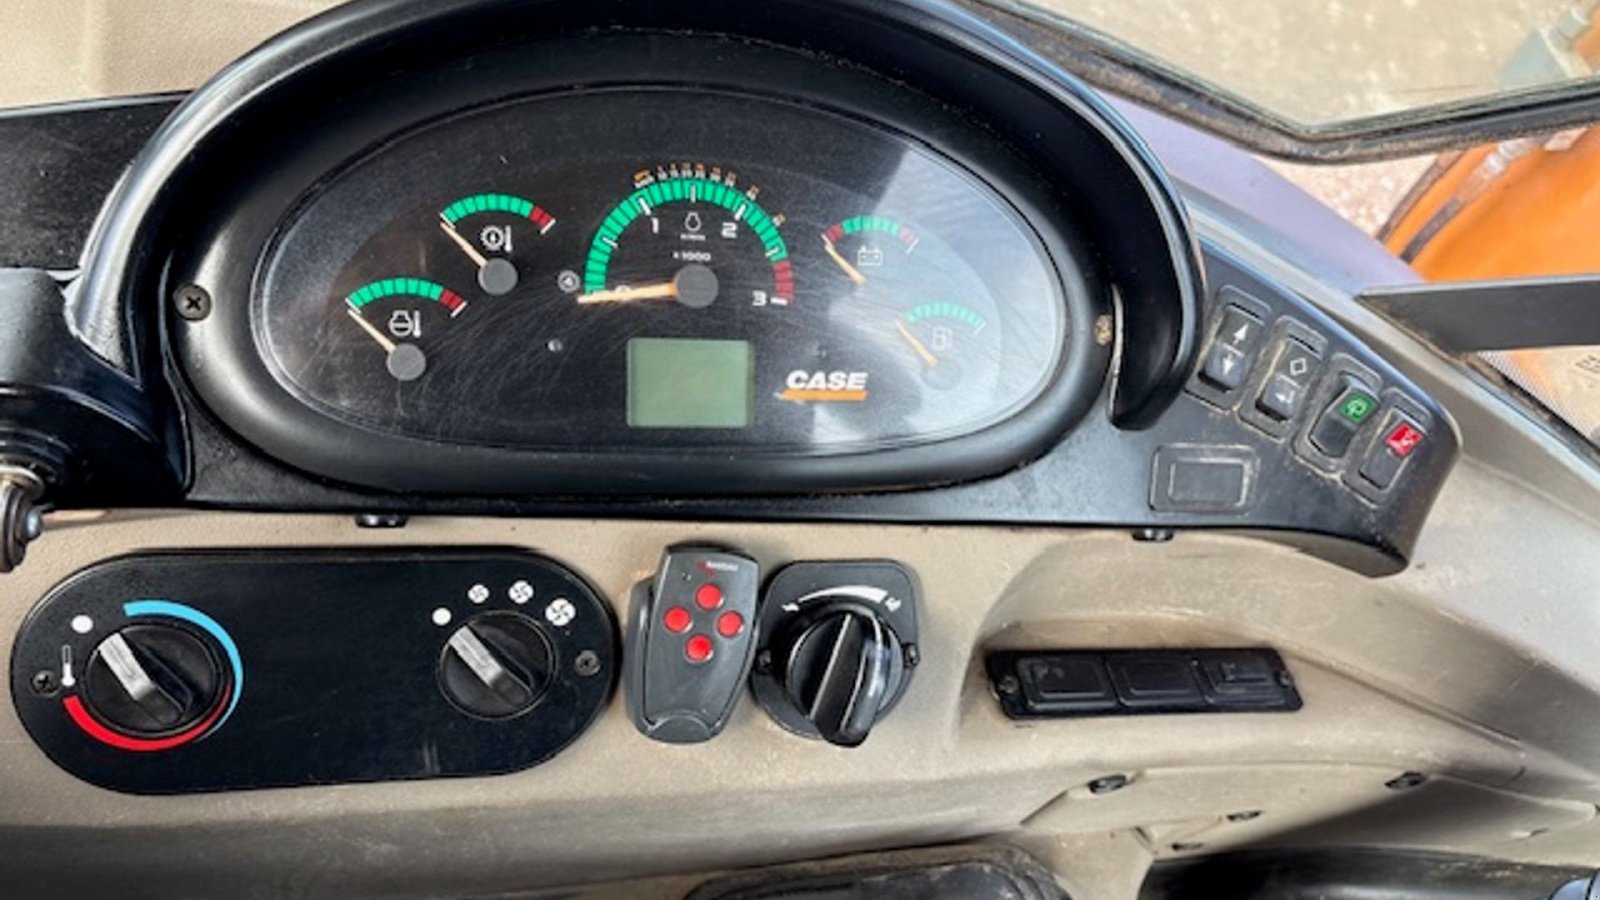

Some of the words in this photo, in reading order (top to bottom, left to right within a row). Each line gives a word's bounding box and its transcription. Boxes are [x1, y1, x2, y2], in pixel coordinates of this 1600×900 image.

[651, 217, 659, 234] 1
[722, 222, 738, 239] 2
[682, 250, 712, 262] 1000
[752, 289, 767, 306] 3
[786, 369, 869, 391] CASE
